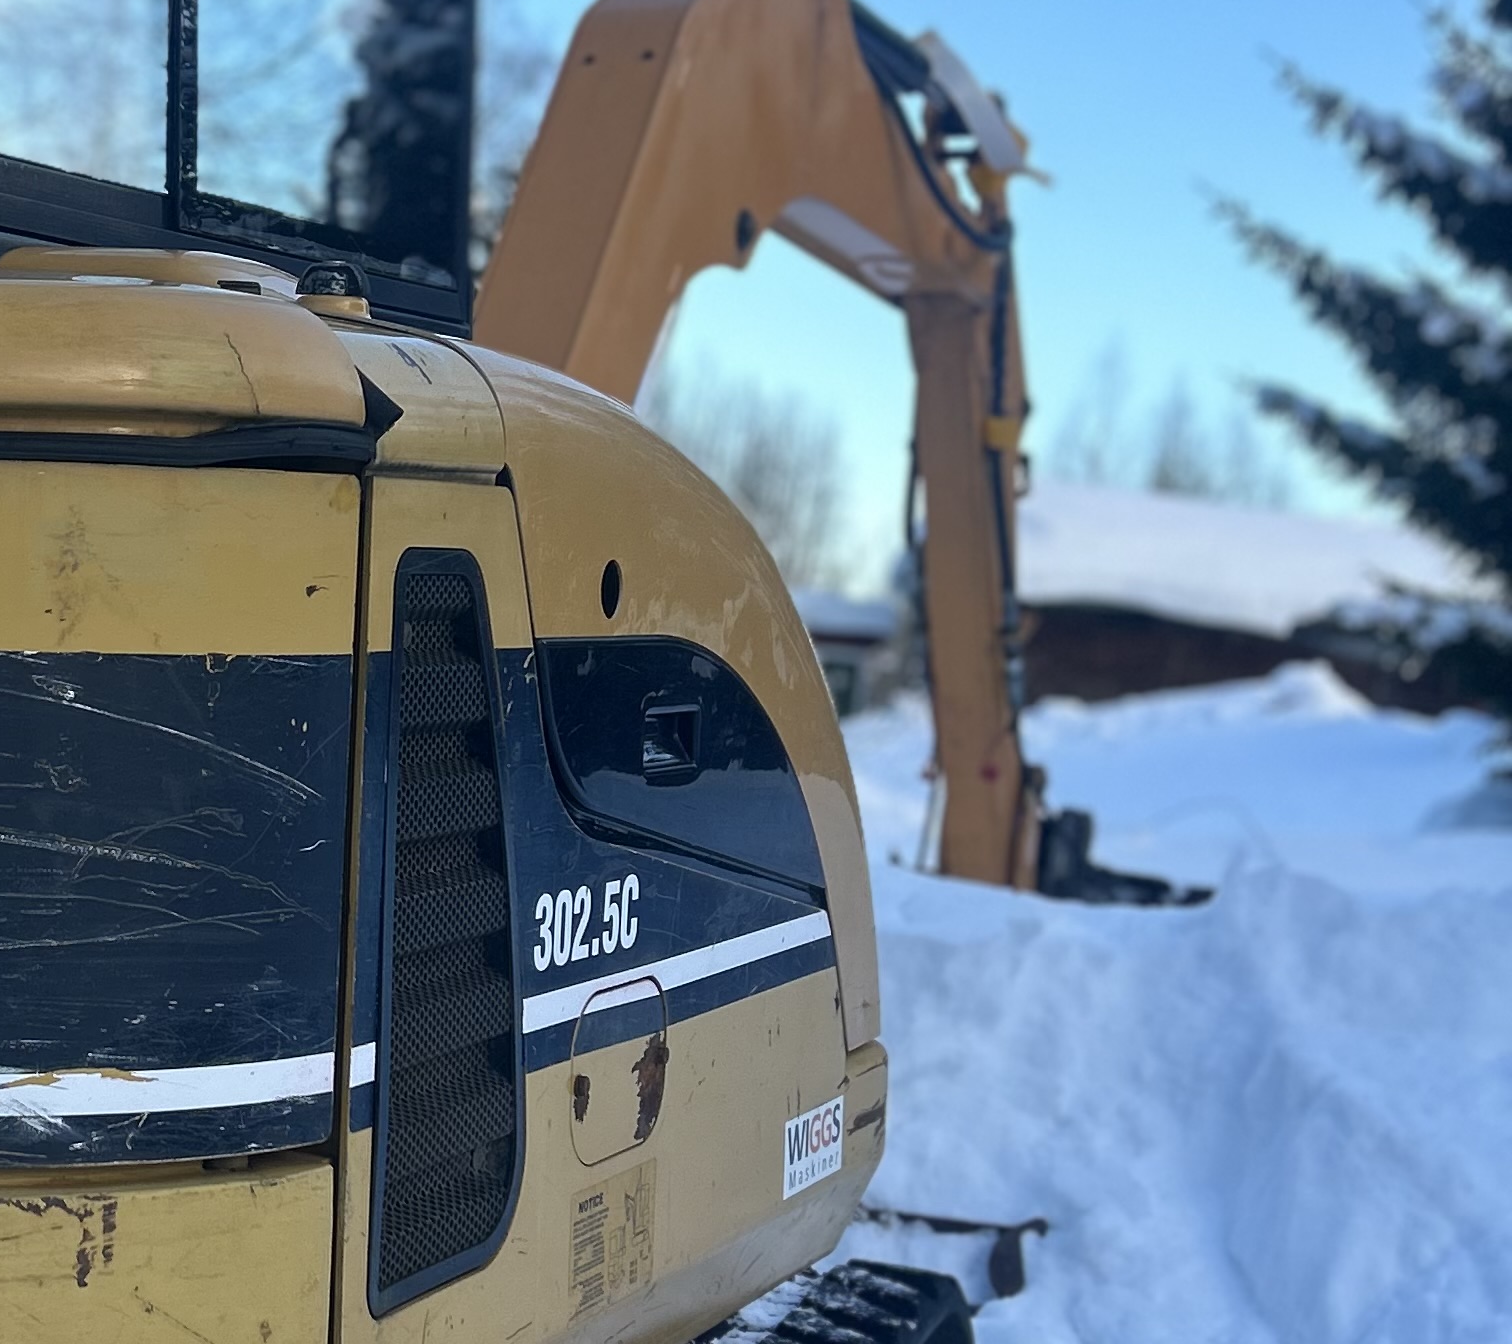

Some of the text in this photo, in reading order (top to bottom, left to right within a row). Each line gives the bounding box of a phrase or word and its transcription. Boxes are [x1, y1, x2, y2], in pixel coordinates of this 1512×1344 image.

[533, 873, 640, 972] 302.5C
[788, 1103, 841, 1166] WIGGS
[788, 1151, 839, 1190] Maskiner
[578, 1192, 604, 1213] NOTICE
